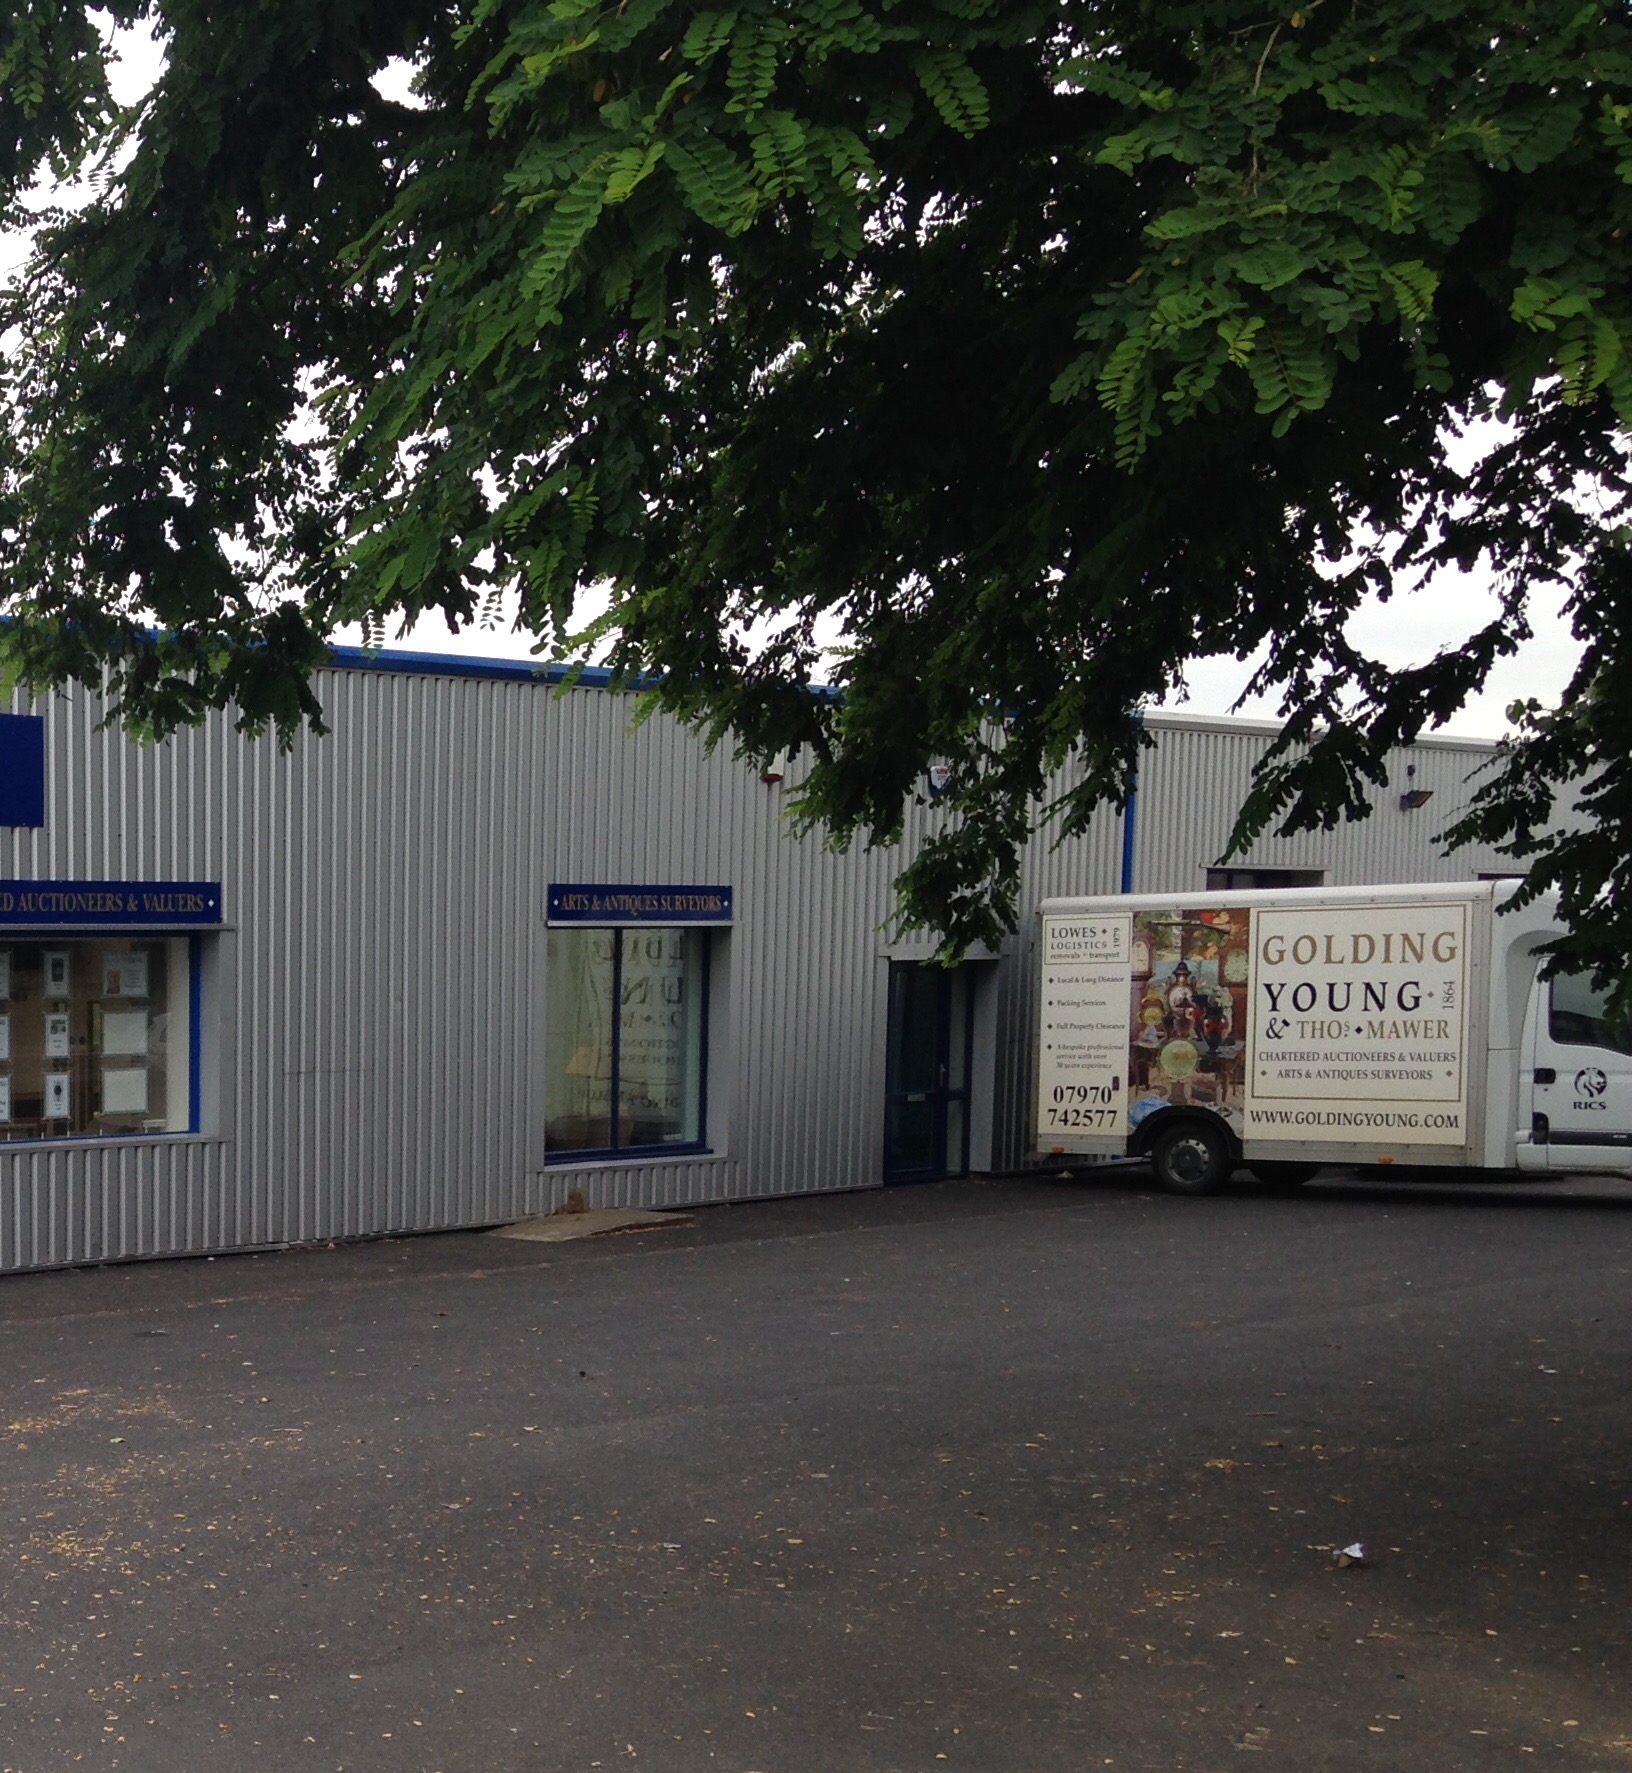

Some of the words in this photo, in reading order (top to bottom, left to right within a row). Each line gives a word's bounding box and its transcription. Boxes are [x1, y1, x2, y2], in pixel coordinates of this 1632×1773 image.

[17, 892, 123, 912] AUCTIONEERS
[127, 893, 138, 912] &
[143, 893, 204, 912] VALUERS
[561, 894, 590, 911] ARTS
[592, 895, 600, 911] &
[604, 895, 658, 916] ANTIQUES
[661, 895, 722, 912] SURVEYORS
[1051, 927, 1097, 939] LOWES
[1050, 941, 1108, 950] LOGISTICS
[1262, 931, 1458, 966] GOLDING
[1263, 981, 1423, 1013] YOUNG
[1443, 980, 1456, 1010] 1864
[1266, 1017, 1291, 1040] &
[1367, 1020, 1450, 1040] MAWER
[1259, 1051, 1319, 1062] CHARTERED
[1322, 1052, 1396, 1062] AUCTIONEERS
[1397, 1052, 1406, 1062] &
[1409, 1052, 1456, 1063] VALUERS
[1277, 1069, 1302, 1079] ARTS
[1305, 1069, 1312, 1079] &
[1315, 1069, 1368, 1081] ANTIQUES
[1370, 1069, 1433, 1080] SURVEYORS
[1053, 1085, 1112, 1104] 07970
[1573, 1101, 1607, 1110] RICS
[1048, 1108, 1117, 1127] 742577
[1250, 1110, 1459, 1128] WWW.GOLDINGYOUNG.COM
